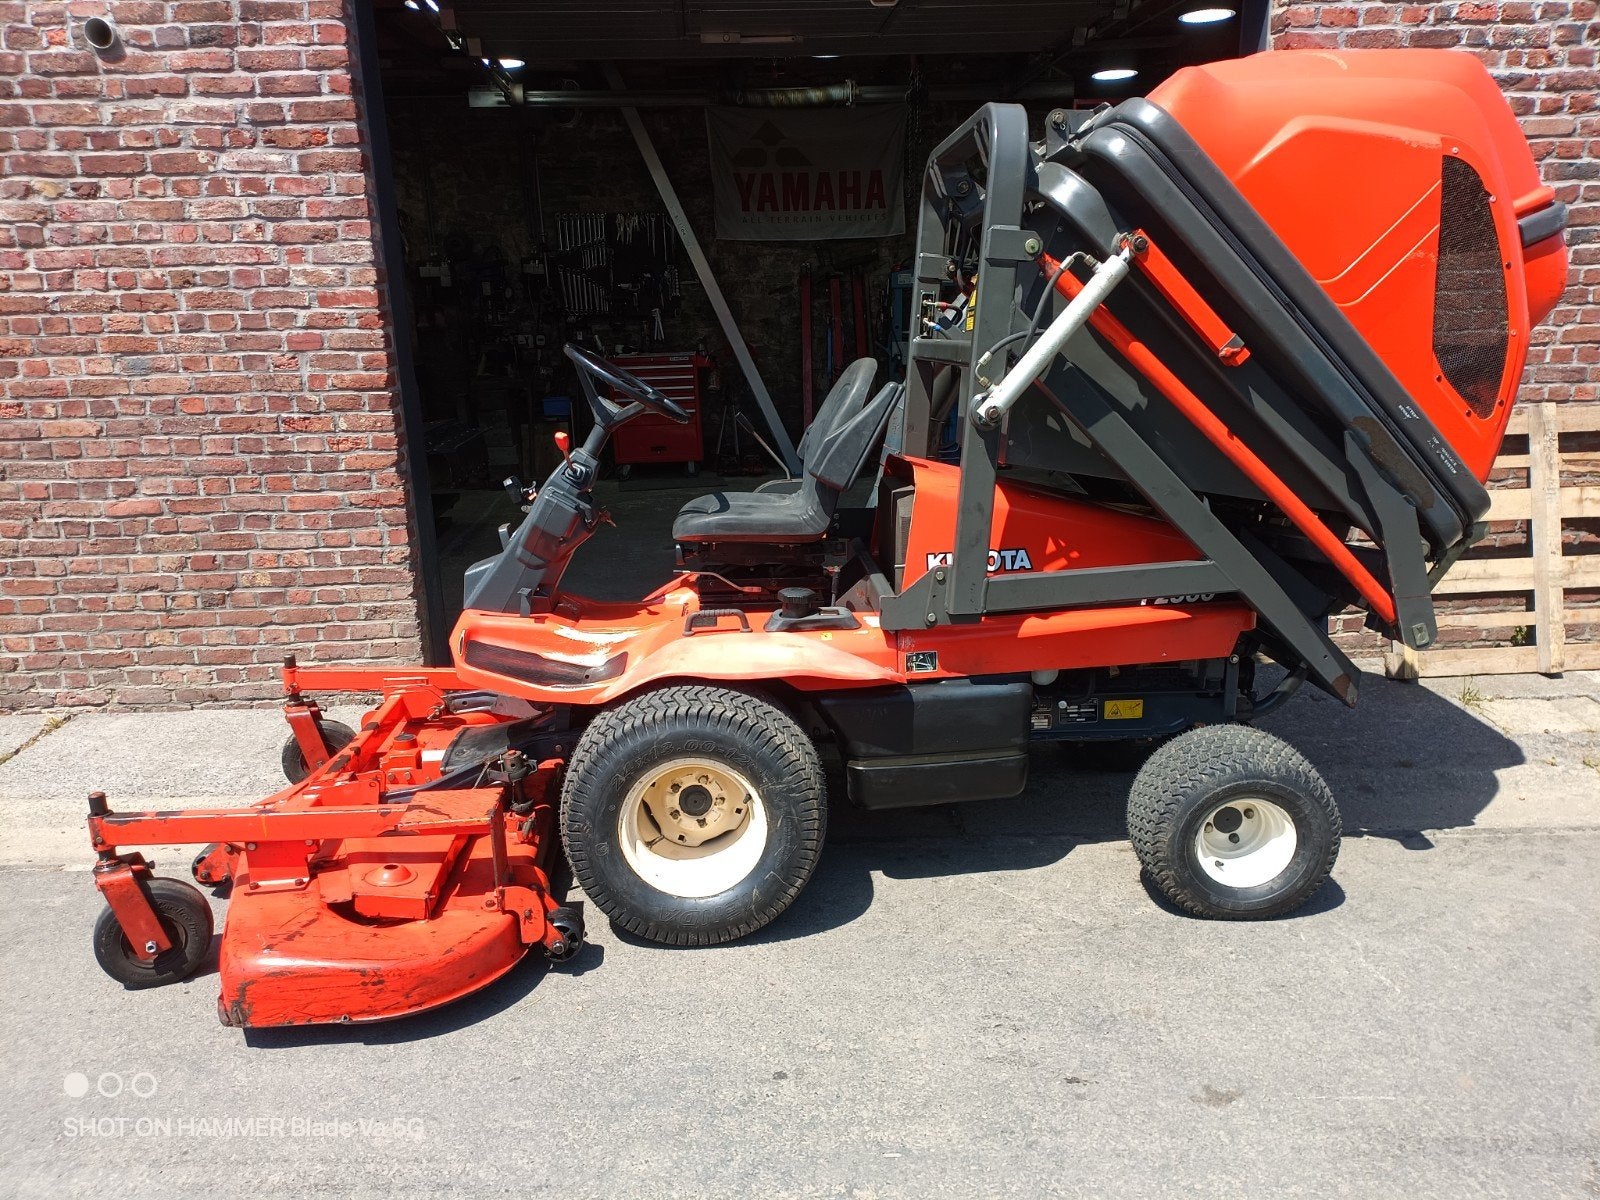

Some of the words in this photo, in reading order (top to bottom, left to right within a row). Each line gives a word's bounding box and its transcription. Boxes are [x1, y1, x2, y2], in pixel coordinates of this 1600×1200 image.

[733, 170, 887, 212] YAMAHA
[742, 215, 763, 224] ALL
[770, 215, 822, 224] TERRAIN
[830, 213, 888, 223] VEHICLES
[927, 549, 1032, 572] KOTA
